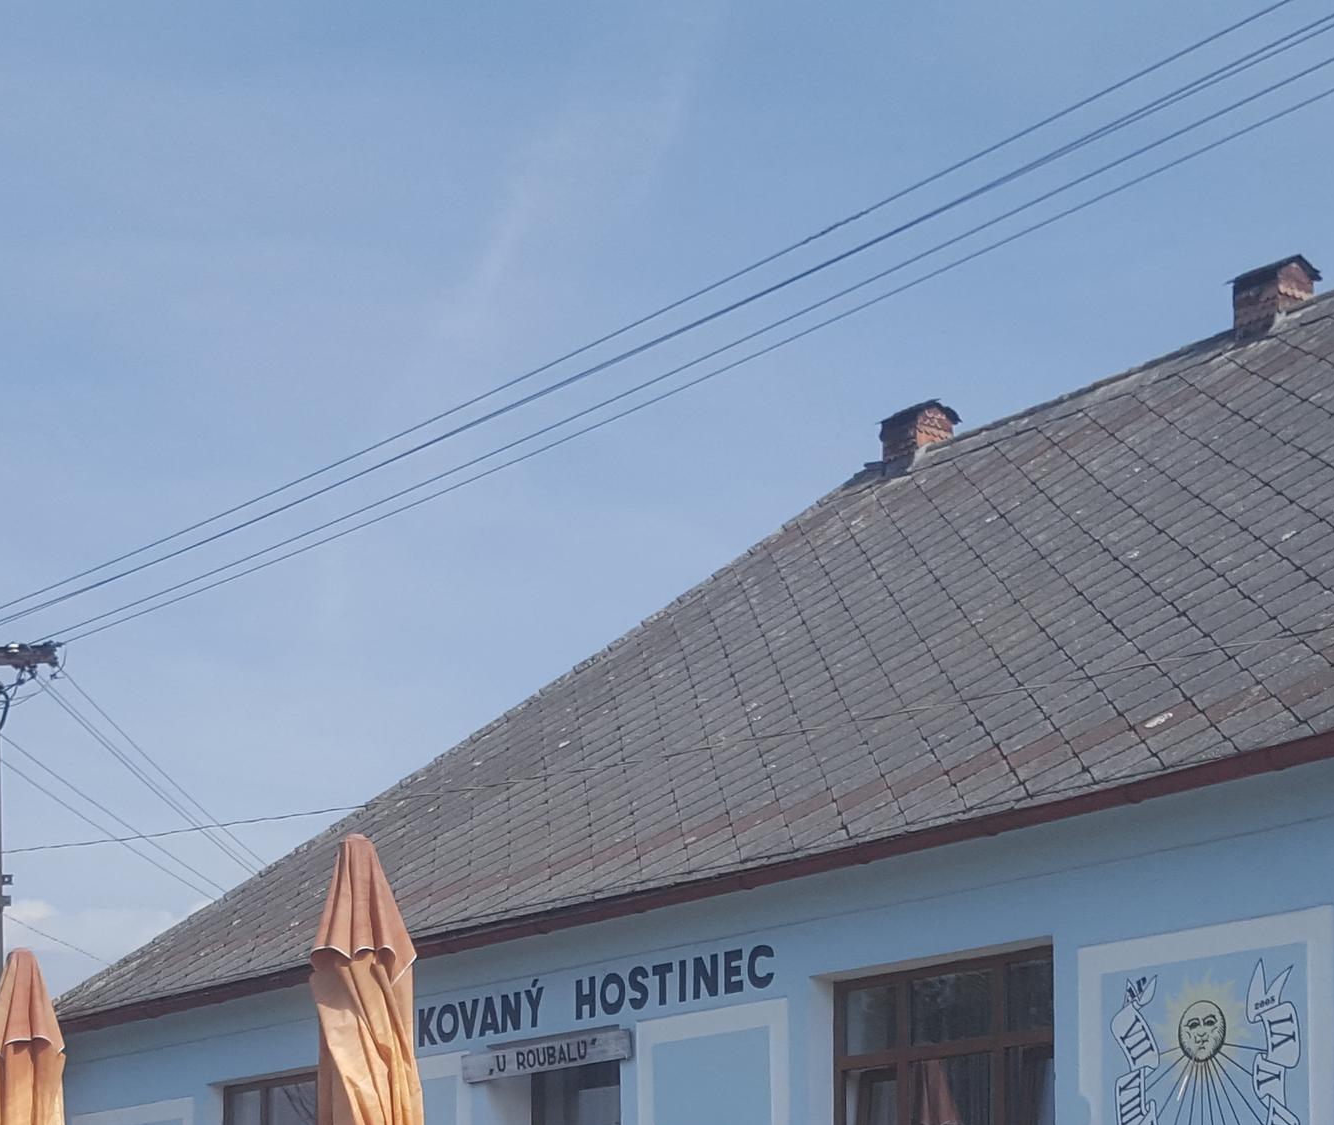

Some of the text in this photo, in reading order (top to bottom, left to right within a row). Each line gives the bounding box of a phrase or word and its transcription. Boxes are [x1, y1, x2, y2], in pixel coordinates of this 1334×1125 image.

[575, 945, 775, 1020] HOSTINEC
[1120, 1015, 1155, 1066] VII
[1256, 1064, 1281, 1091] V
